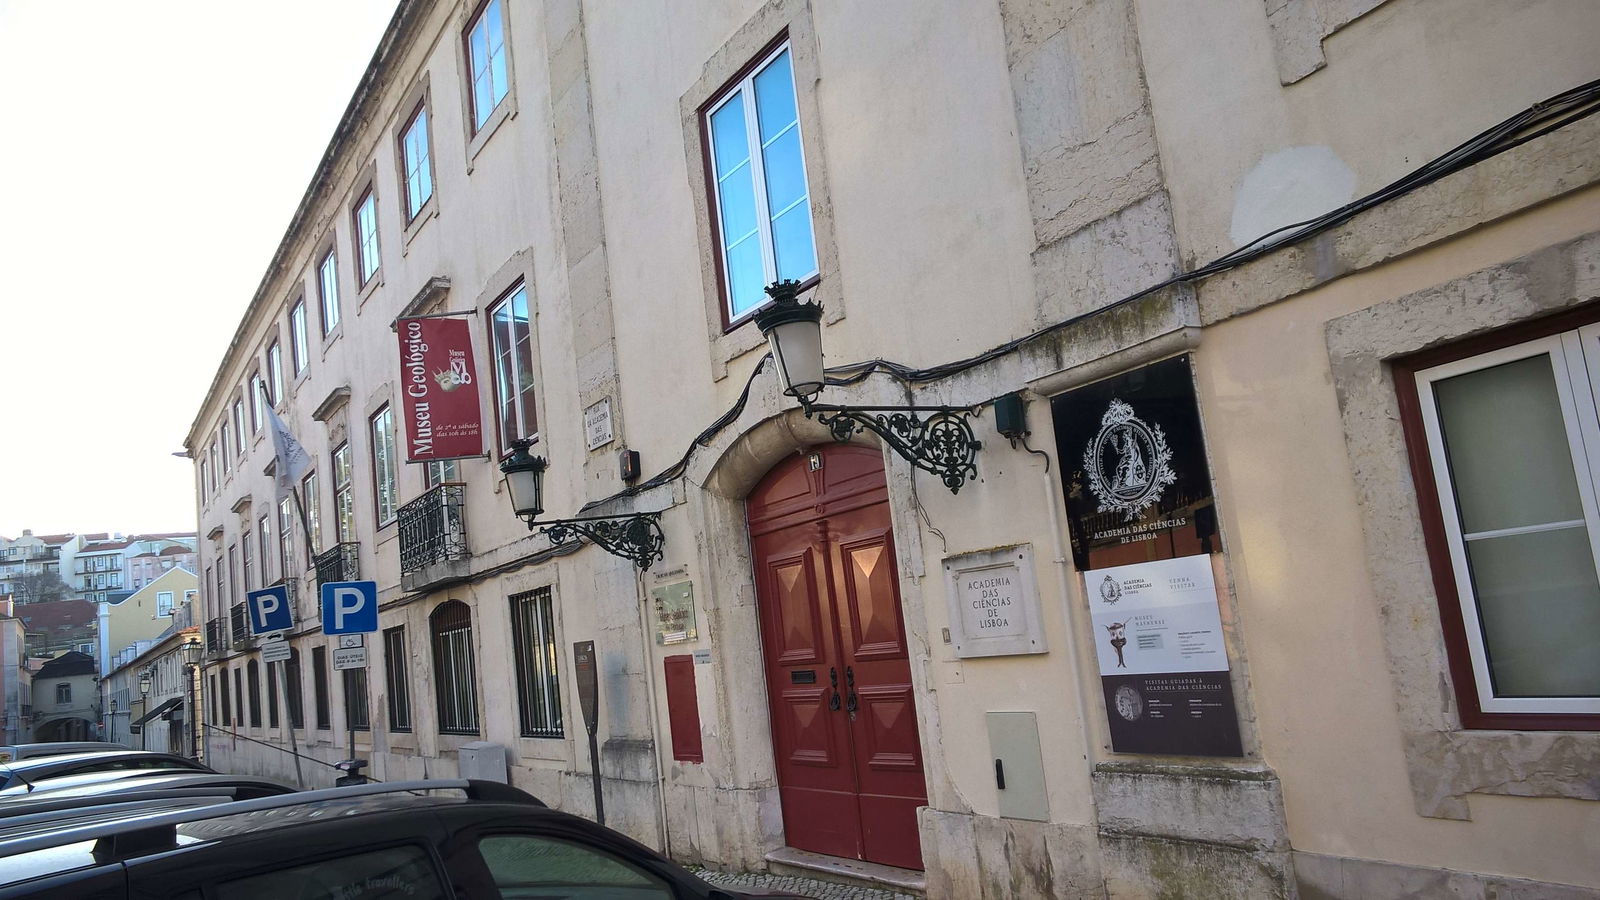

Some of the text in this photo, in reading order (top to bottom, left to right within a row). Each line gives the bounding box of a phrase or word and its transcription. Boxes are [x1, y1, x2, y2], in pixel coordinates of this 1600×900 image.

[405, 322, 433, 455] Museu Geológico
[436, 423, 445, 431] de
[1094, 517, 1186, 540] ACADEMIA DAS CIÊNCIAS
[1121, 532, 1158, 544] DE LISBOA
[968, 577, 1011, 590] ACADEMIA
[982, 588, 999, 599] DAS
[256, 594, 280, 628] P
[334, 587, 366, 630] P
[988, 608, 998, 618] DE
[980, 618, 1009, 629] LISBOA
